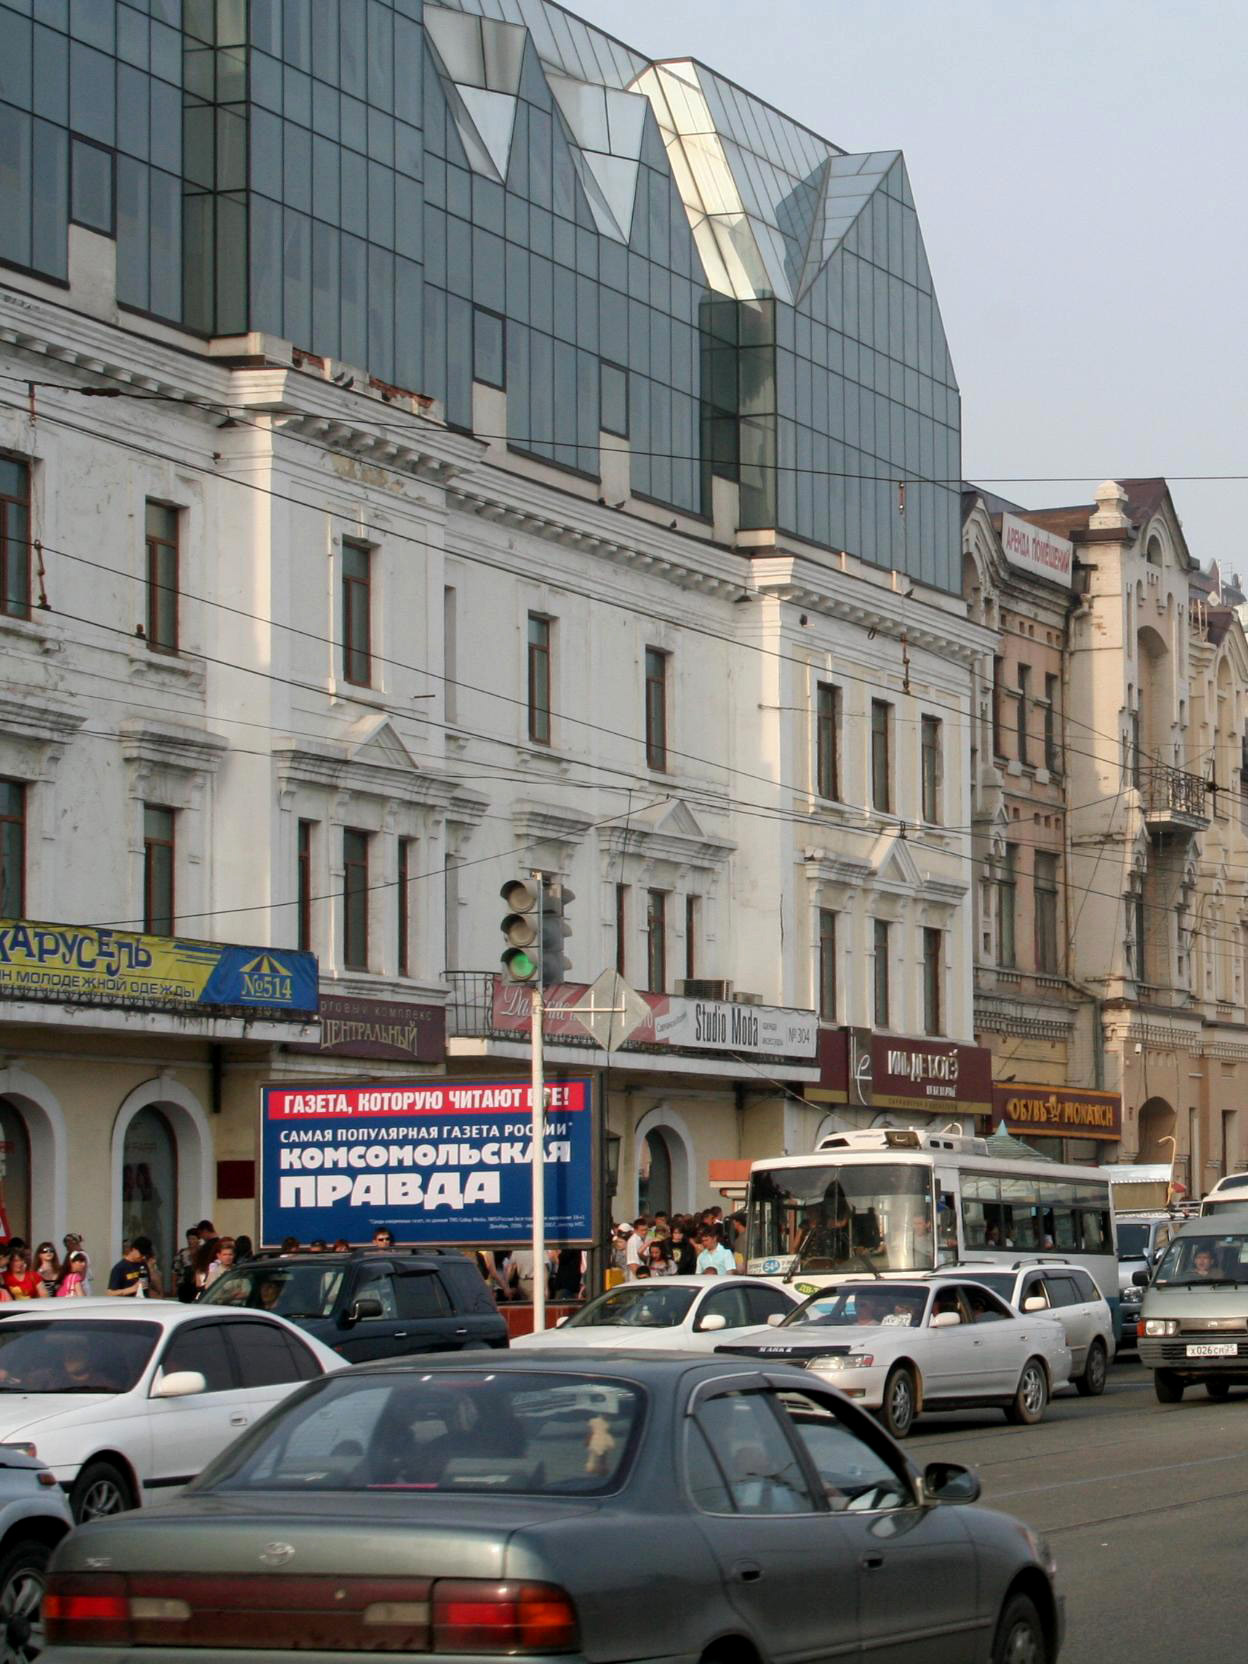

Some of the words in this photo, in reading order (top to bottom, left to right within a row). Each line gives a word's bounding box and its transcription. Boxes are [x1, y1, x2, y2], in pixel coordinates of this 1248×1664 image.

[16, 974, 127, 991] МОЛОДЕЖНОЙ
[130, 981, 195, 998] ОДЕЖДЫ
[320, 1018, 418, 1056] ЦЕНТРАЛЬНЫЙ
[695, 1003, 727, 1043] Studio
[731, 1007, 759, 1047] Moda
[284, 1094, 353, 1115] ГАЗЕТА,
[358, 1090, 444, 1112] КОТОРУЮ
[449, 1088, 524, 1109] ЧИТАЮТ
[280, 1130, 333, 1143] САМАЯ
[337, 1127, 438, 1141] ПОПУЛЯРНАЯ
[443, 1125, 500, 1138] ГАЗЕТА
[280, 1140, 572, 1169] КОМСОМОЛЬСКАЯ
[280, 1171, 501, 1210] ПРАВДА
